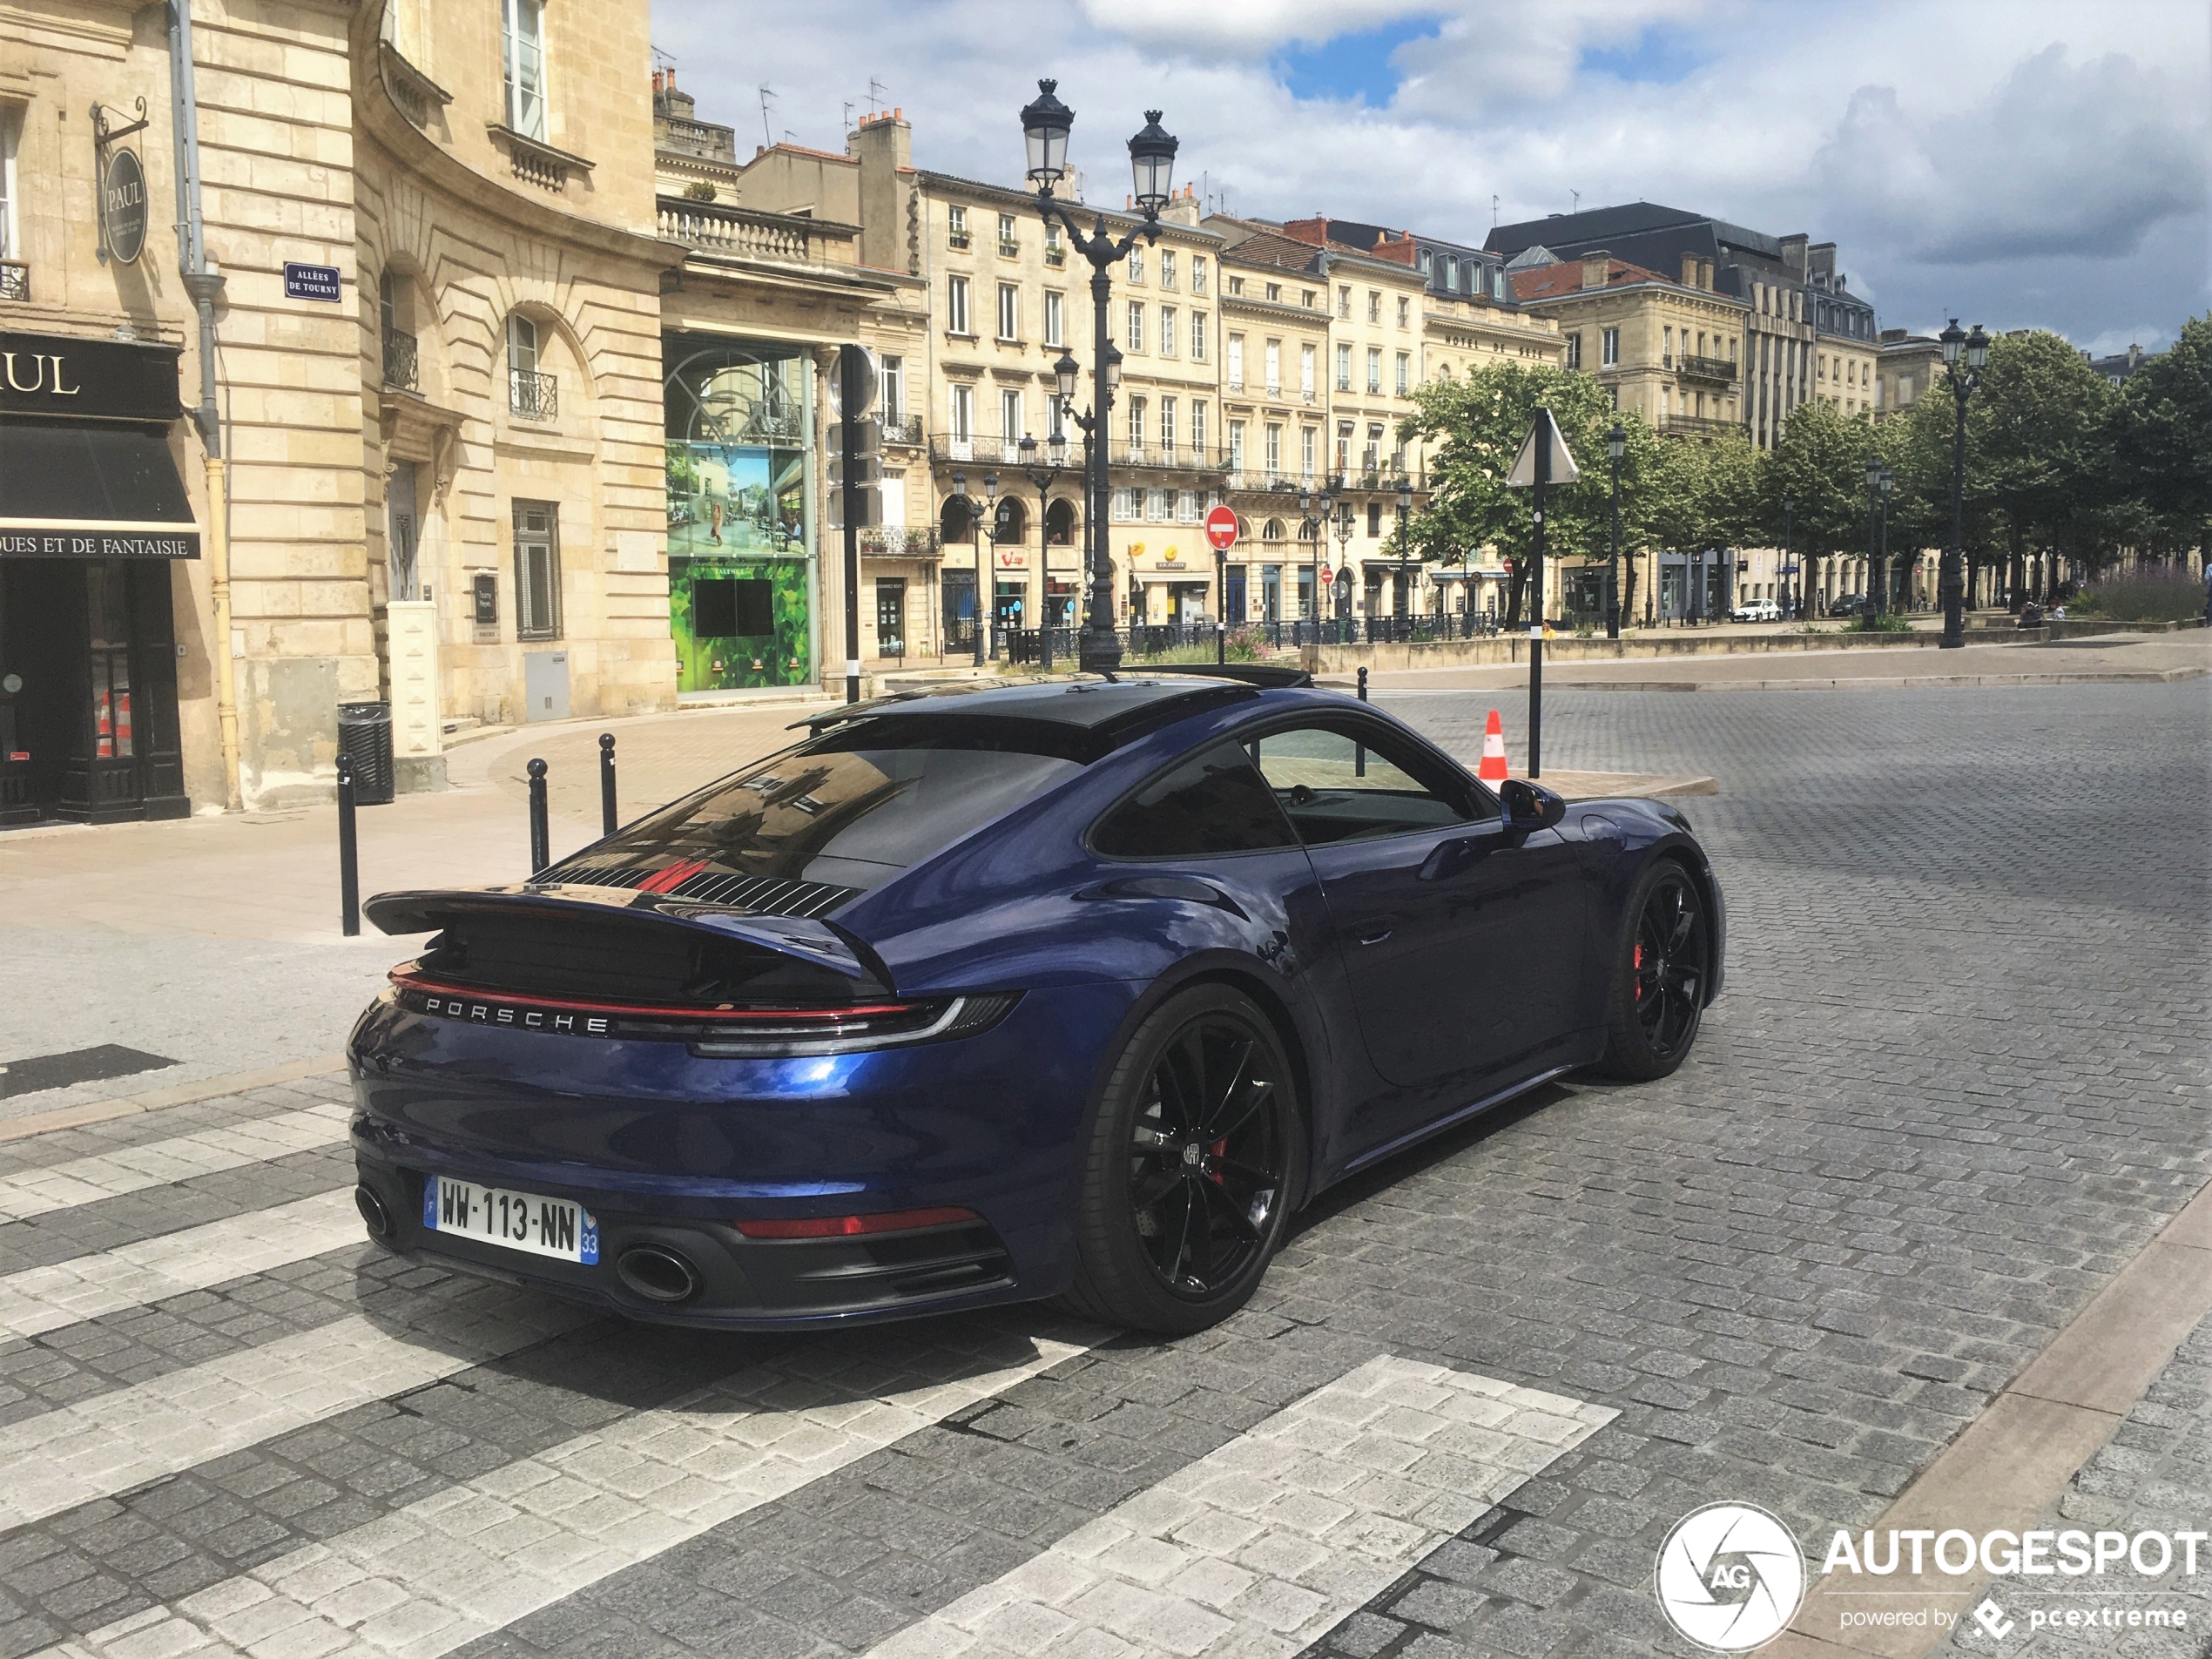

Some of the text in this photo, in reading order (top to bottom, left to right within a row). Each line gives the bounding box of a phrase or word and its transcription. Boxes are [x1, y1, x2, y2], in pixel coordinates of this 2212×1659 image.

[108, 182, 142, 212] PAUL
[297, 271, 328, 281] ALLÉES
[289, 281, 337, 294] DE TOURNY
[0, 353, 81, 395] UL
[0, 536, 188, 555] UES ET DE FANTAISIE
[426, 998, 608, 1033] PORSCHE
[428, 1201, 434, 1212] F
[442, 1181, 575, 1251] WW-113-NN
[582, 1232, 598, 1254] 33
